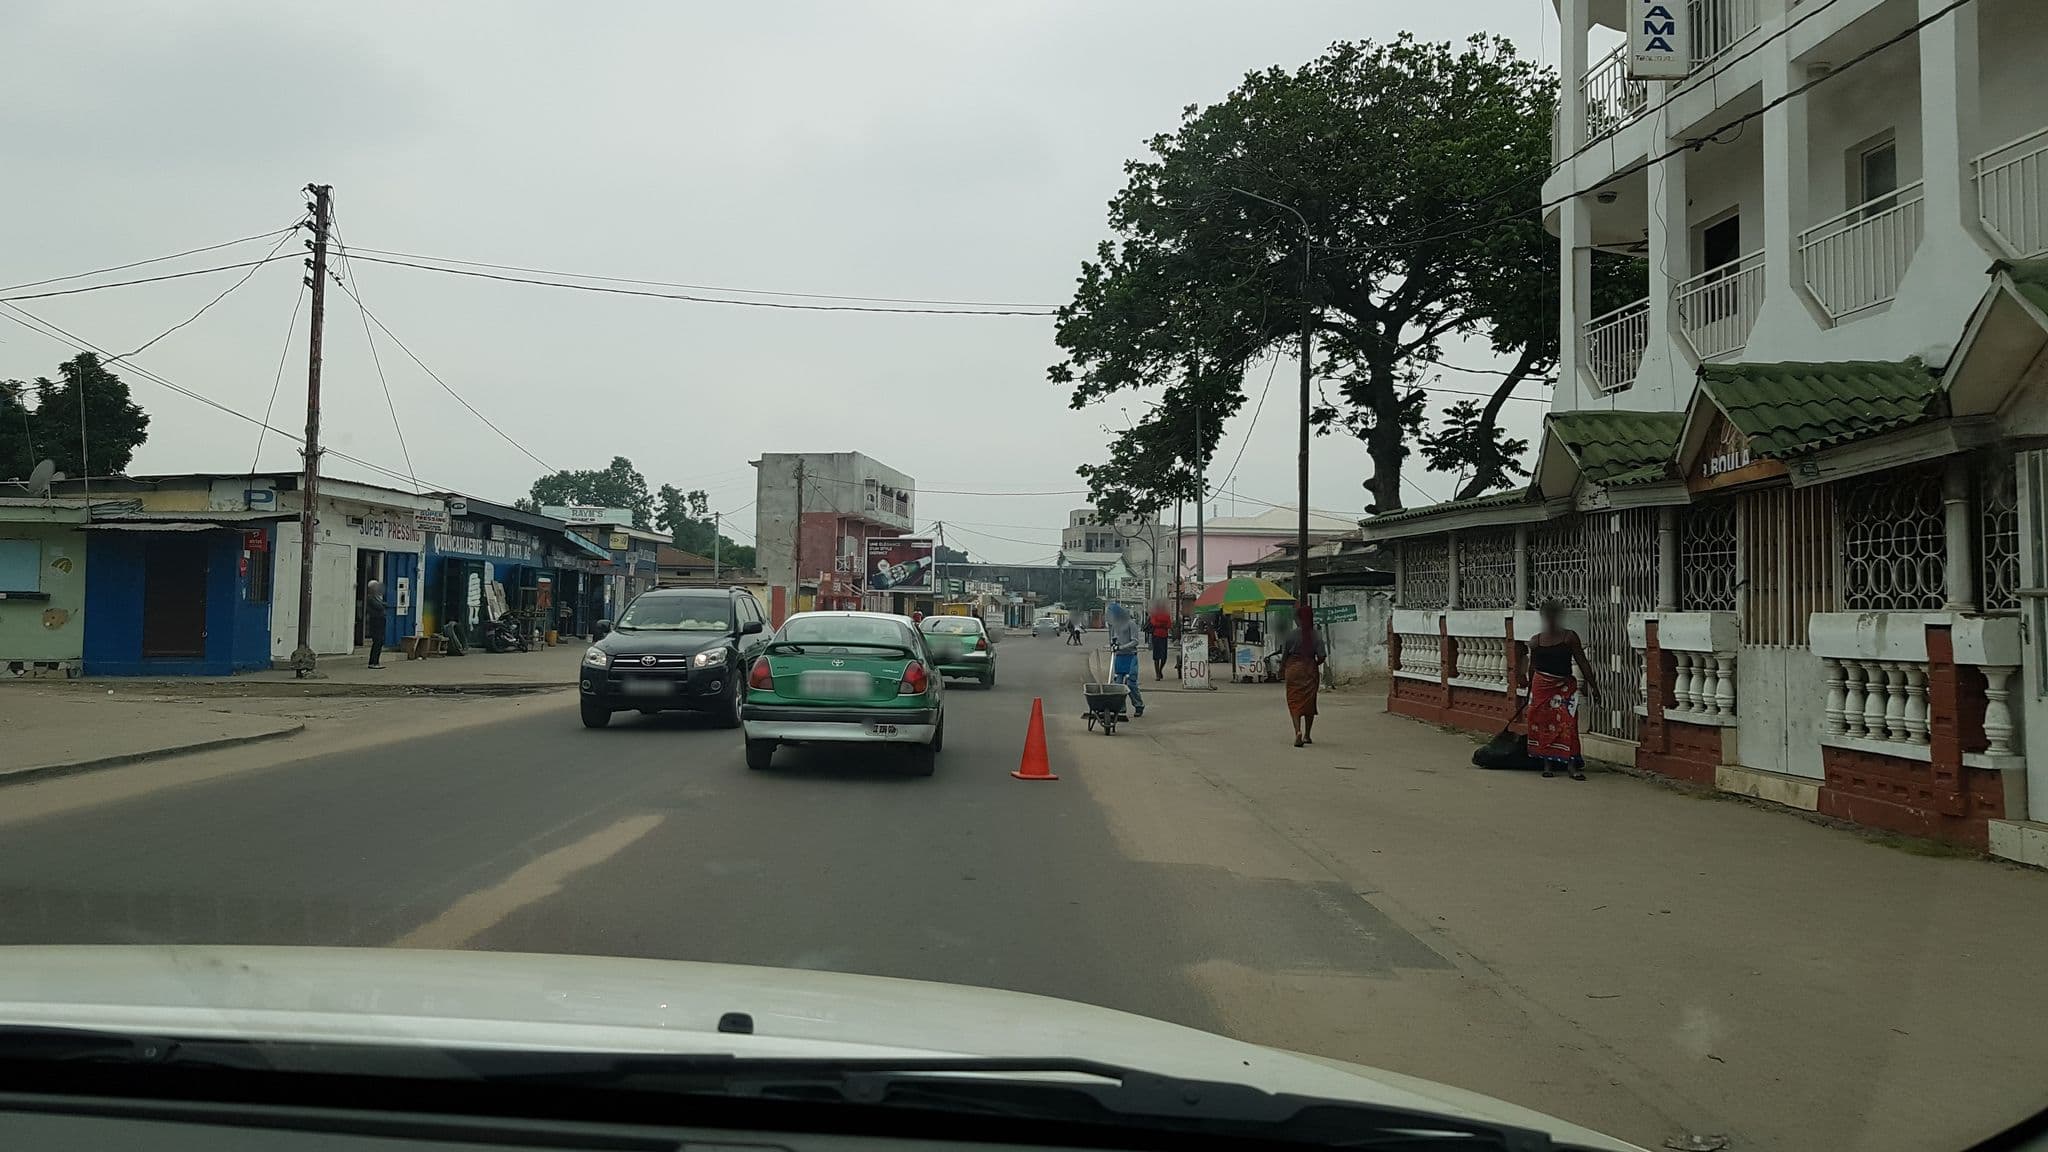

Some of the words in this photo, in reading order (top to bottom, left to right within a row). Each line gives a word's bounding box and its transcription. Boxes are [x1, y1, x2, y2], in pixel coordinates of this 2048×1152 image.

[360, 518, 384, 537] SUPER
[387, 522, 420, 542] PRESSING
[434, 533, 483, 555] QUINCAILLERIE
